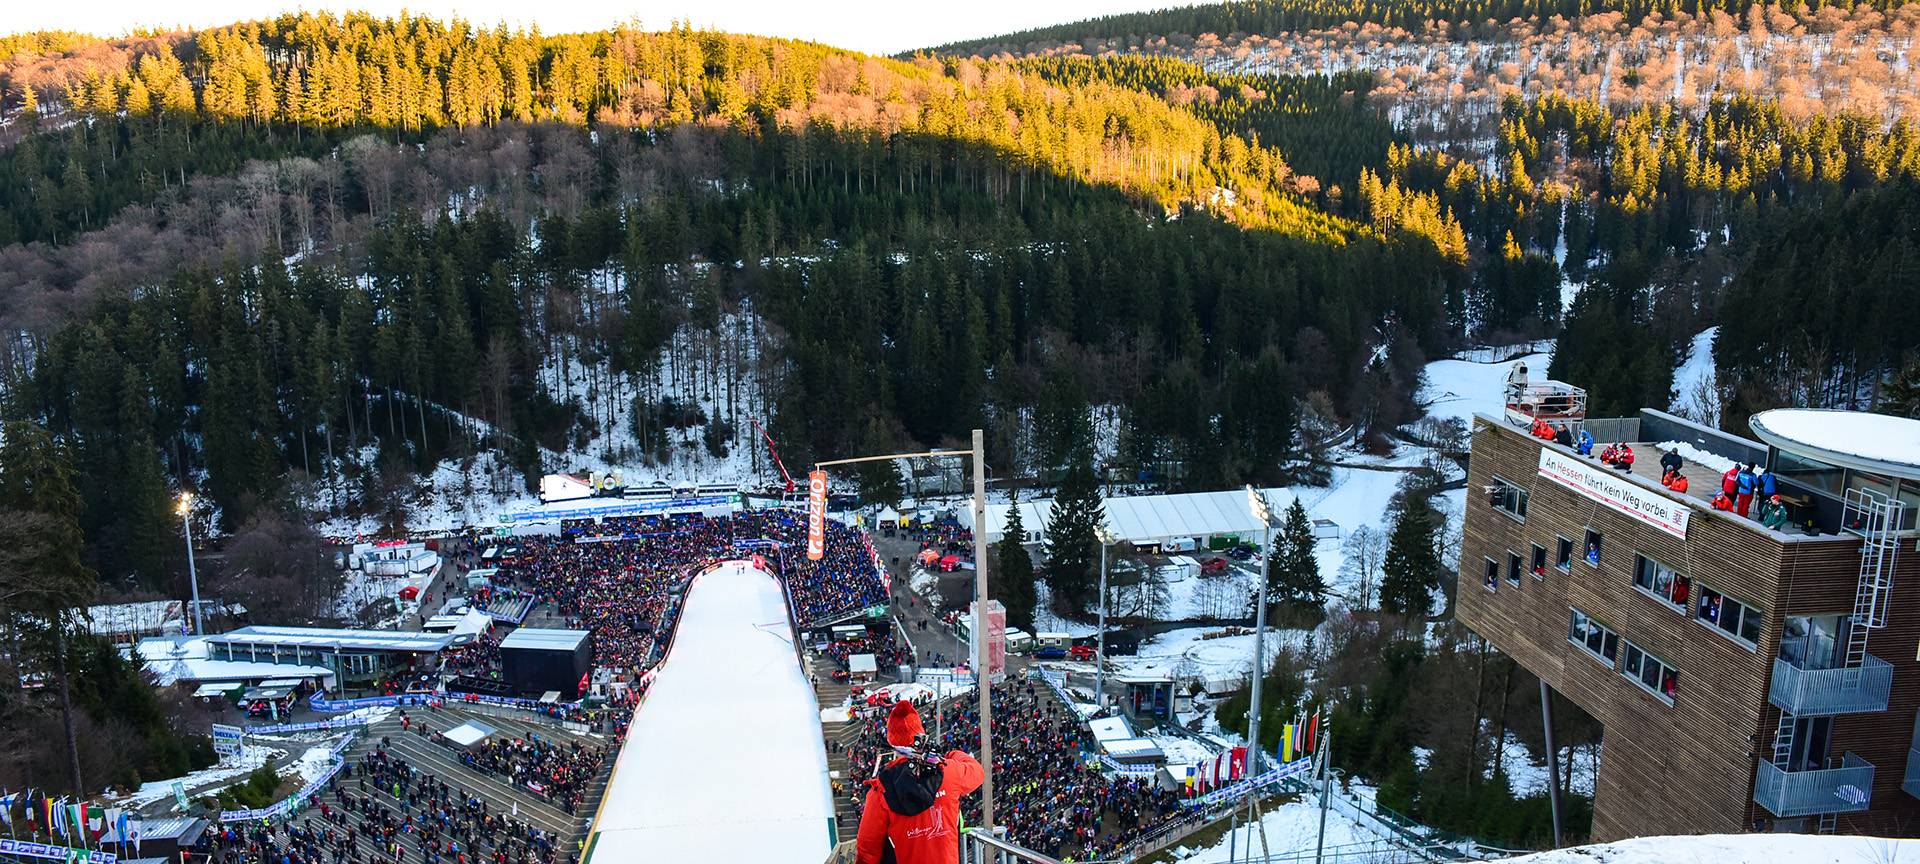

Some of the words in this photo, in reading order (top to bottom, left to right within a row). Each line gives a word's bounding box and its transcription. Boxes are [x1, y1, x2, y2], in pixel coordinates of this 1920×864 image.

[1545, 457, 1556, 470] An
[1557, 461, 1583, 481] Hessen
[1585, 474, 1603, 492] führt
[1604, 484, 1621, 498] kein
[1622, 489, 1640, 509] Weg
[1642, 500, 1670, 521] vorbei.
[215, 731, 240, 739] DELTA-V
